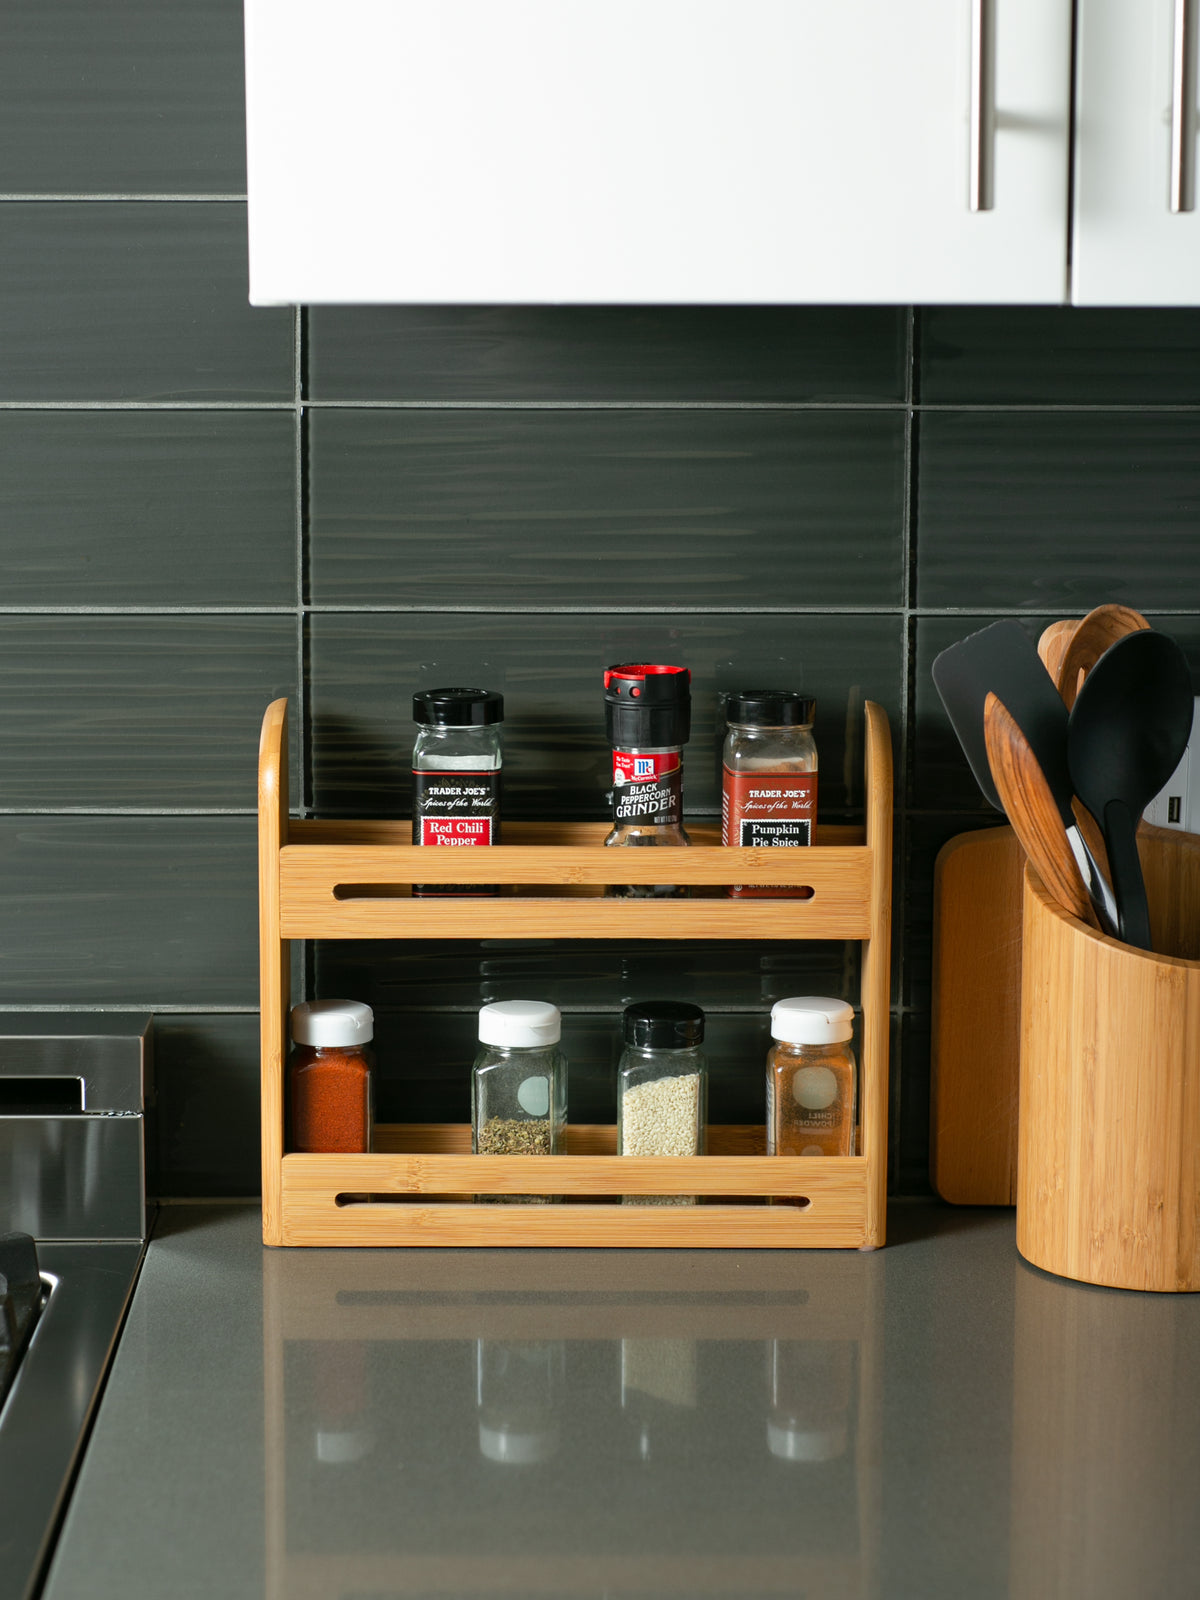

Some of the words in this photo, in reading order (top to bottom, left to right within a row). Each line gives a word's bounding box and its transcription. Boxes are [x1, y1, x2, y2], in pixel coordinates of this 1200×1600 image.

[428, 787, 462, 795] TRADER
[463, 787, 487, 796] JOE'S
[629, 783, 658, 795] BLACK
[748, 790, 782, 798] TRADER
[782, 790, 806, 798] JOE'S
[620, 787, 672, 805] PEPPERCORN
[420, 797, 447, 811] Spices
[471, 798, 495, 807] World
[616, 795, 676, 818] GRINDER
[740, 800, 767, 813] Spices
[791, 800, 814, 809] World
[429, 822, 453, 834] Red
[456, 822, 484, 834] Chili
[751, 824, 800, 836] Pumpkin
[436, 834, 477, 846] Pepper
[751, 837, 769, 847] Pie
[771, 837, 800, 847] Spice
